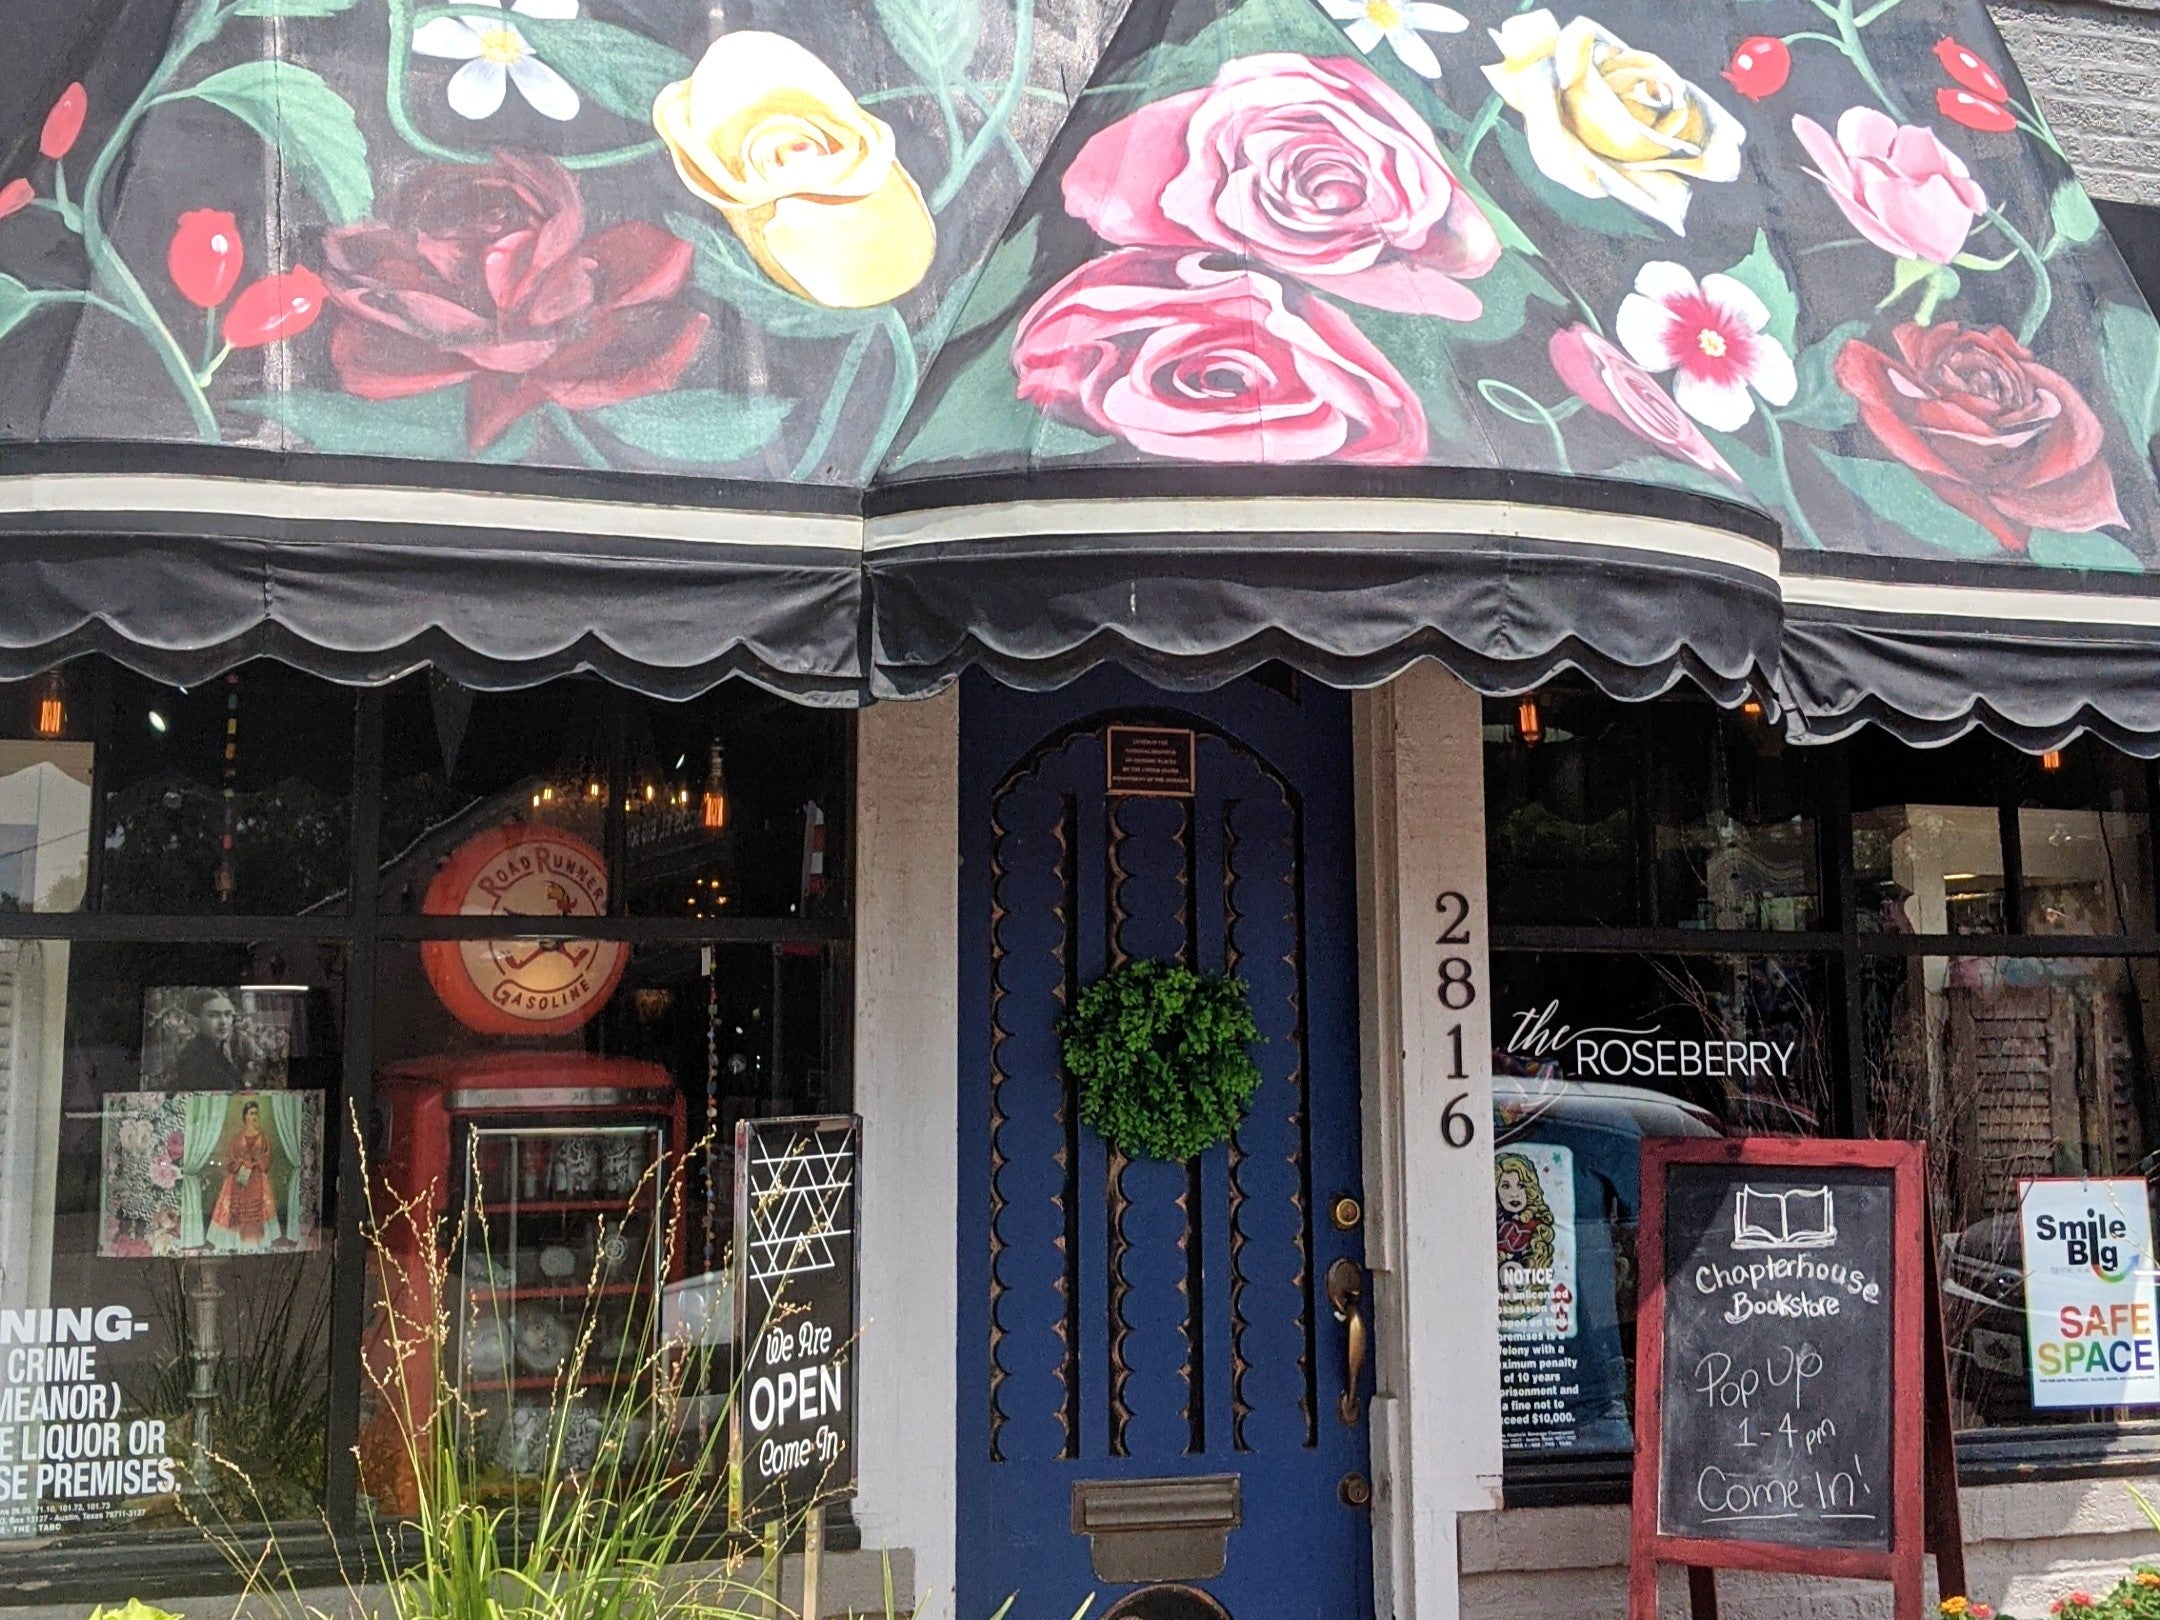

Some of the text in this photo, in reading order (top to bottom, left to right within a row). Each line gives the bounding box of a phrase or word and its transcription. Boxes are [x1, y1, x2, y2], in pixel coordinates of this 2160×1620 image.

[478, 846, 604, 904] ROAD RUNNER
[493, 978, 591, 1011] GASOLINE
[1434, 891, 1476, 1149] 2816
[1576, 1039, 1796, 1077] ROSEBERRY
[2035, 1208, 2127, 1242] Smile
[2067, 1239, 2119, 1272] Big
[1503, 1268, 1554, 1285] NOTICE
[0, 1304, 149, 1344] NING-
[1724, 1291, 1840, 1324] Bookstore
[2060, 1303, 2151, 1339] SAFE
[765, 1321, 832, 1365] We Are
[1532, 1343, 1556, 1355] with
[2037, 1339, 2155, 1376] SPACE
[7, 1345, 97, 1384] CRIME
[1503, 1372, 1561, 1384] of 10 years
[1539, 1357, 1578, 1370] penalty
[1695, 1351, 1759, 1408] Pop
[749, 1363, 842, 1432] OPEN
[1511, 1400, 1531, 1411] fine
[1533, 1399, 1551, 1410] not
[1553, 1399, 1565, 1409] to
[1559, 1384, 1579, 1395] and
[22, 1422, 121, 1463] LIQUOR
[129, 1420, 166, 1455] OR
[759, 1425, 840, 1477] Come In
[1806, 1418, 1836, 1455] pm
[0, 1457, 182, 1502] SE PREMISES.
[1697, 1454, 1871, 1513] Come In!
[82, 1512, 104, 1521] Texas
[87, 1502, 111, 1511] 101.73
